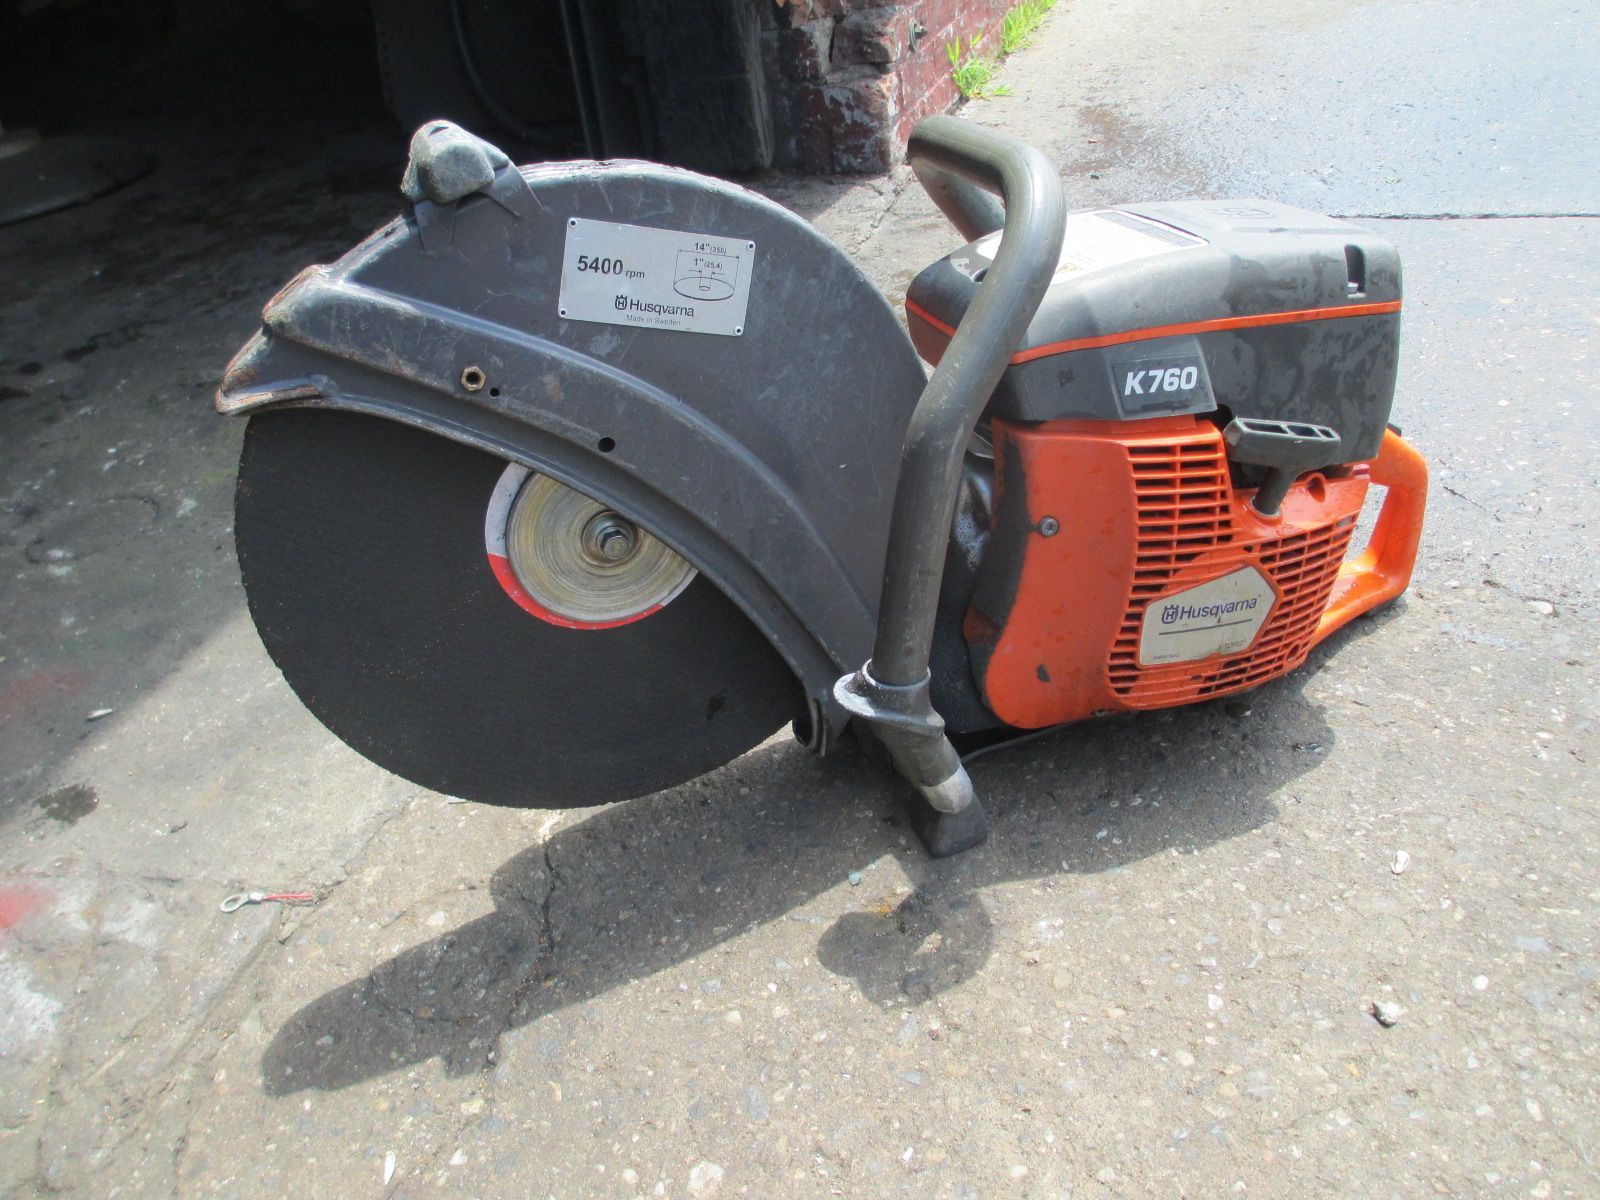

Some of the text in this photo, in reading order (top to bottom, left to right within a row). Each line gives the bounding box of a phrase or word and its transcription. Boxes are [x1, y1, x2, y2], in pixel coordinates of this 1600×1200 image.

[577, 255, 645, 280] 5400 rpm
[629, 299, 695, 317] Husqvarna
[626, 314, 645, 323] Made
[654, 317, 681, 327] Sweden
[1179, 597, 1257, 621] Husqvarna
